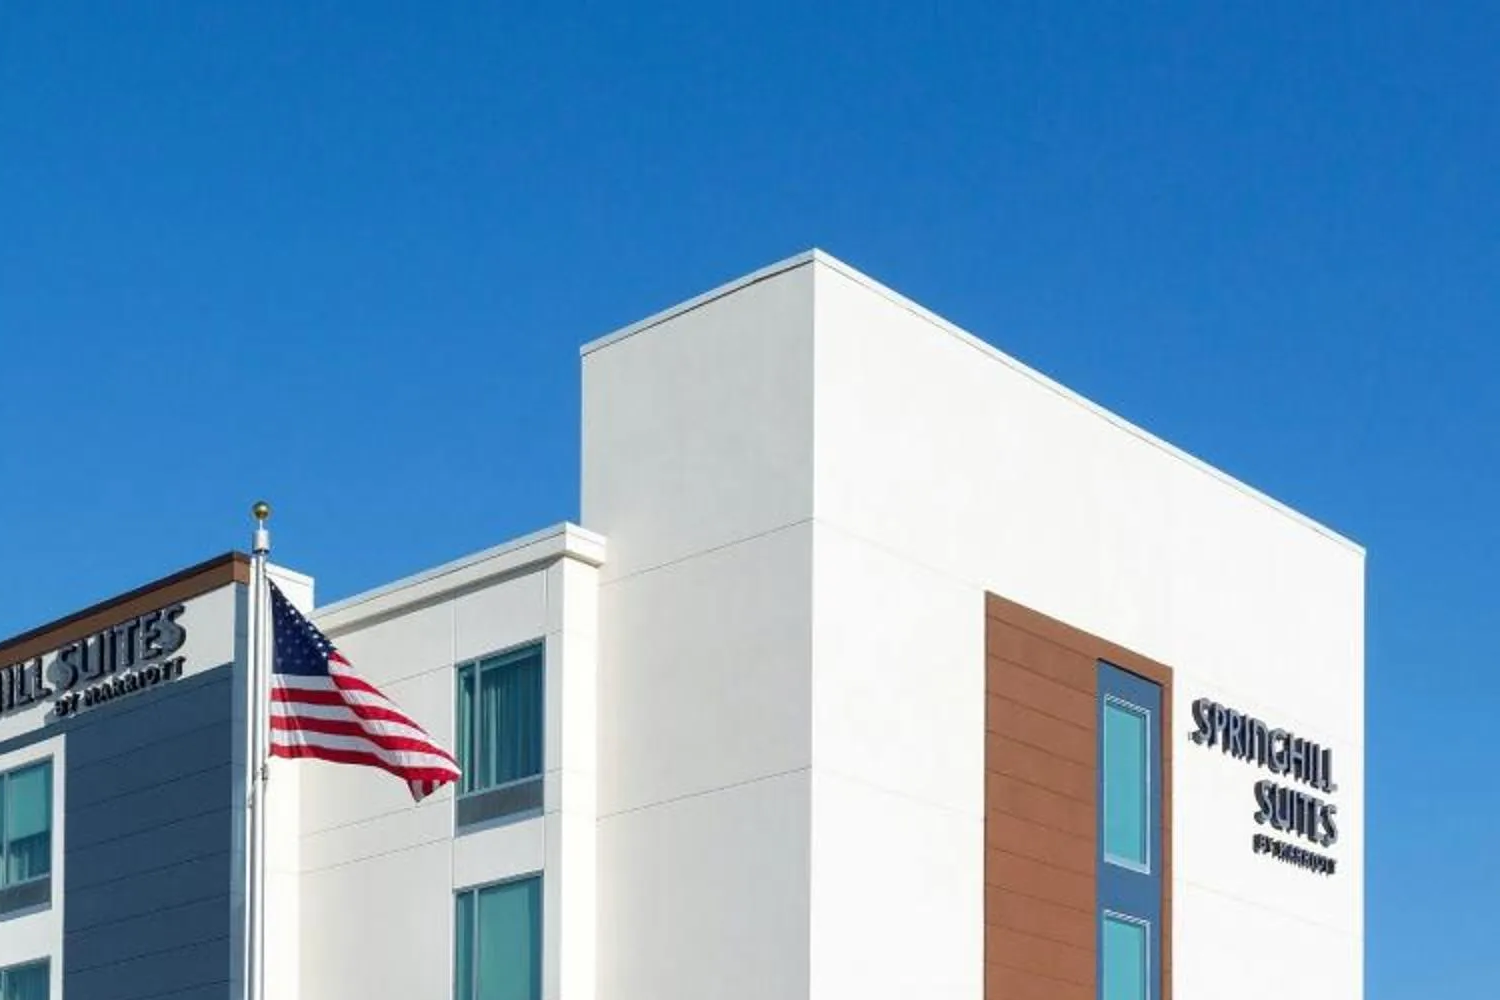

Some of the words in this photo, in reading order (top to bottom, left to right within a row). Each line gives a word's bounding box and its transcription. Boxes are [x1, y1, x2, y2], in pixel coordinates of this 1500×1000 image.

[47, 604, 188, 694] SUITES
[53, 692, 80, 716] BY
[84, 656, 187, 706] MARRIOTT
[1189, 698, 1338, 794] SPRINGHILL
[1254, 779, 1338, 847] SUITES
